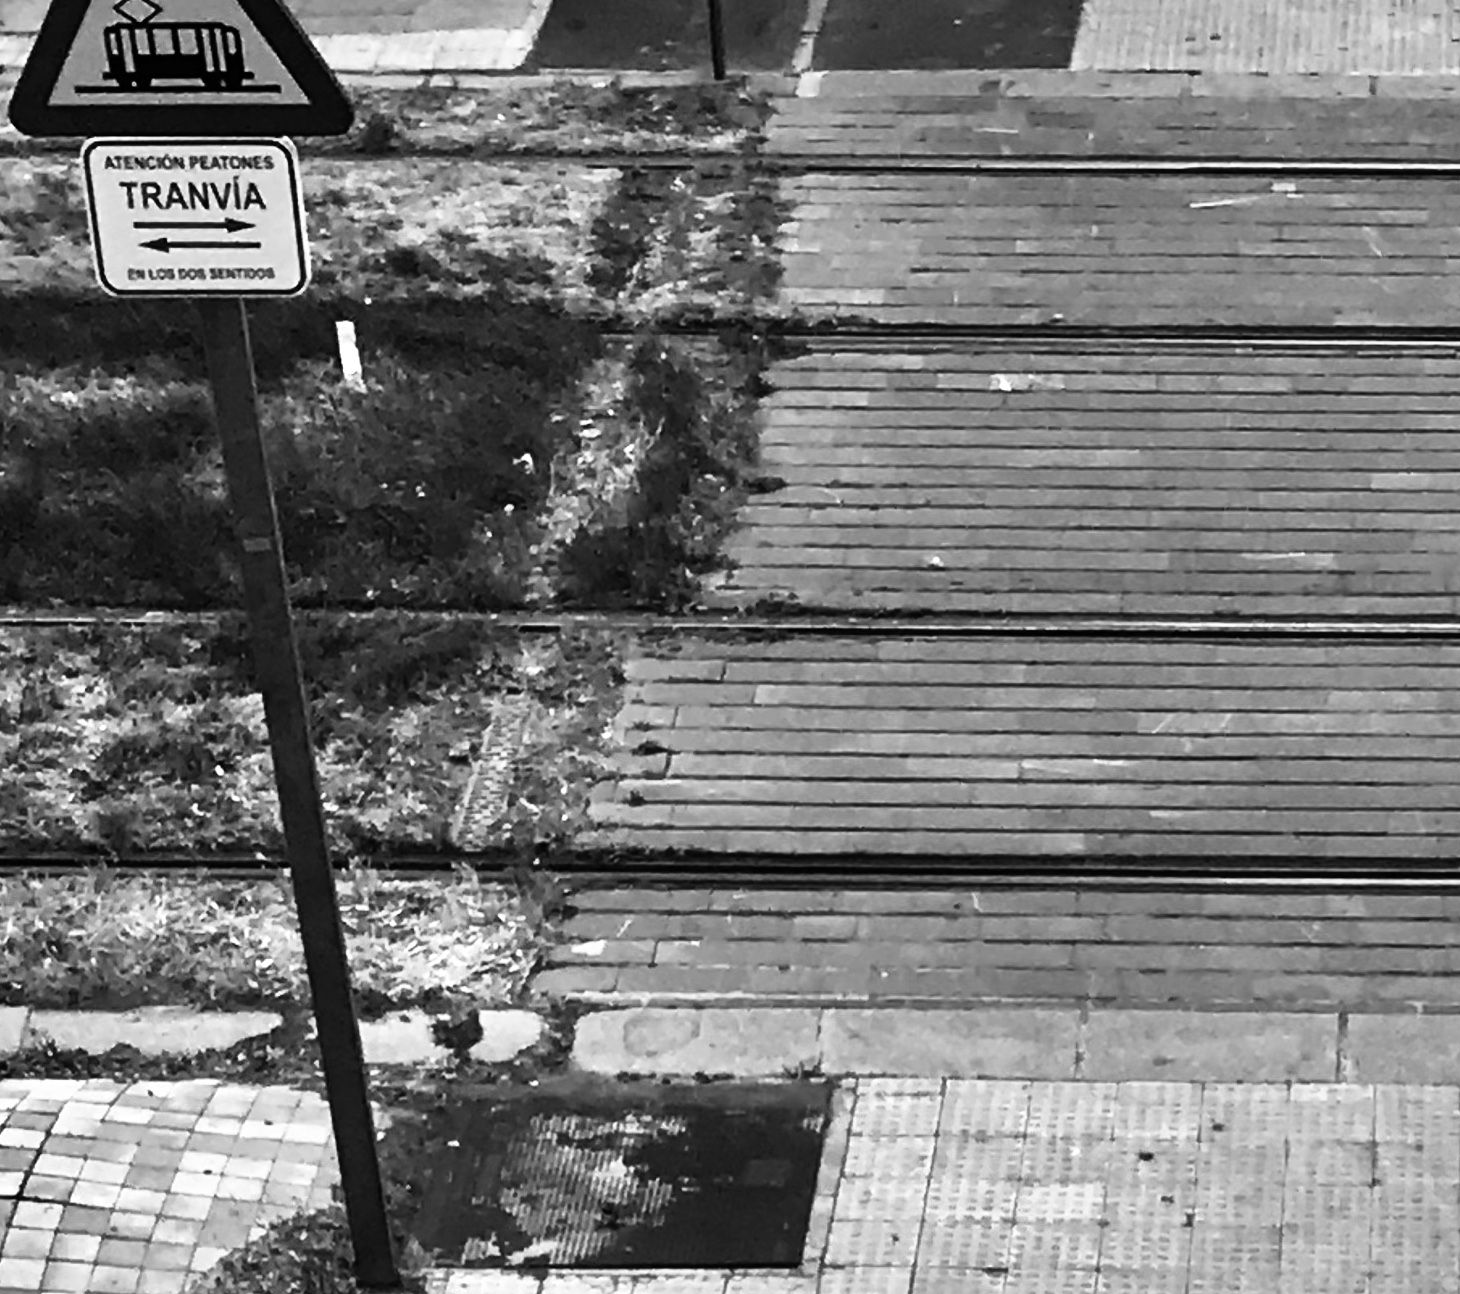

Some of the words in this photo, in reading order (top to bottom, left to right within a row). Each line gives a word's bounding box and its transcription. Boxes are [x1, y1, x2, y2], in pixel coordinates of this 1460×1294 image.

[104, 153, 186, 171] ATENCIÓN
[189, 155, 275, 171] PEATONES
[118, 175, 267, 211] TRANVÍA
[127, 267, 145, 281] EN
[148, 267, 175, 281] LOS
[178, 267, 206, 280] DOS
[209, 266, 276, 280] SENTIDOS
